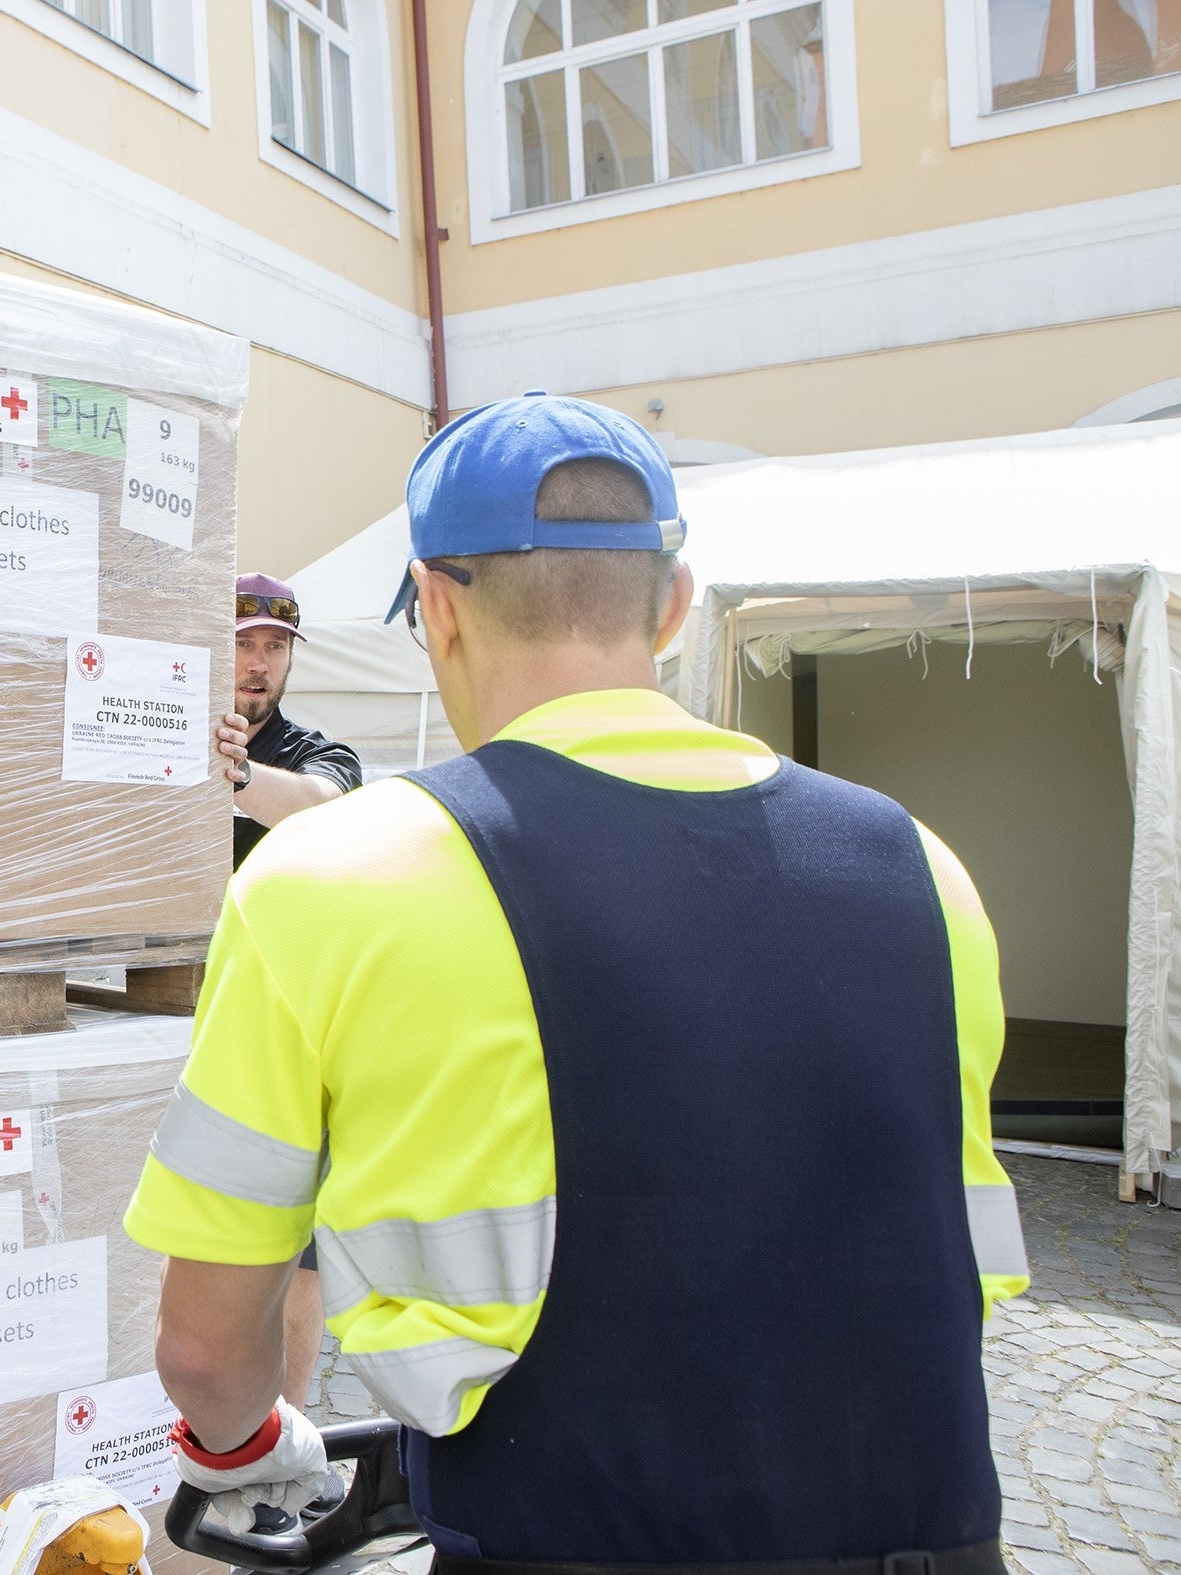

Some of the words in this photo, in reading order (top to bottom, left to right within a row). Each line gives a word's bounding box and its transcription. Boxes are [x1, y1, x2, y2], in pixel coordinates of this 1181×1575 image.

[51, 393, 126, 444] PHA
[159, 419, 172, 440] 9
[160, 452, 180, 468] 163
[182, 458, 195, 473] kg
[127, 477, 192, 518] 99009
[0, 505, 70, 536] clothes
[172, 674, 187, 683] IFRC
[102, 696, 141, 709] HEALTH
[143, 701, 184, 714] STATION
[72, 723, 105, 732] CONSIGNEE:
[96, 711, 120, 724] CTN
[123, 713, 188, 731] 22-0000516
[72, 730, 95, 738] UKRAINE
[123, 734, 142, 742] SOCIETY
[1, 1240, 18, 1258] kg
[5, 1270, 79, 1299] clothes
[91, 1435, 131, 1453] HEALTH
[133, 1422, 174, 1442] STATION
[85, 1455, 109, 1470] CTN
